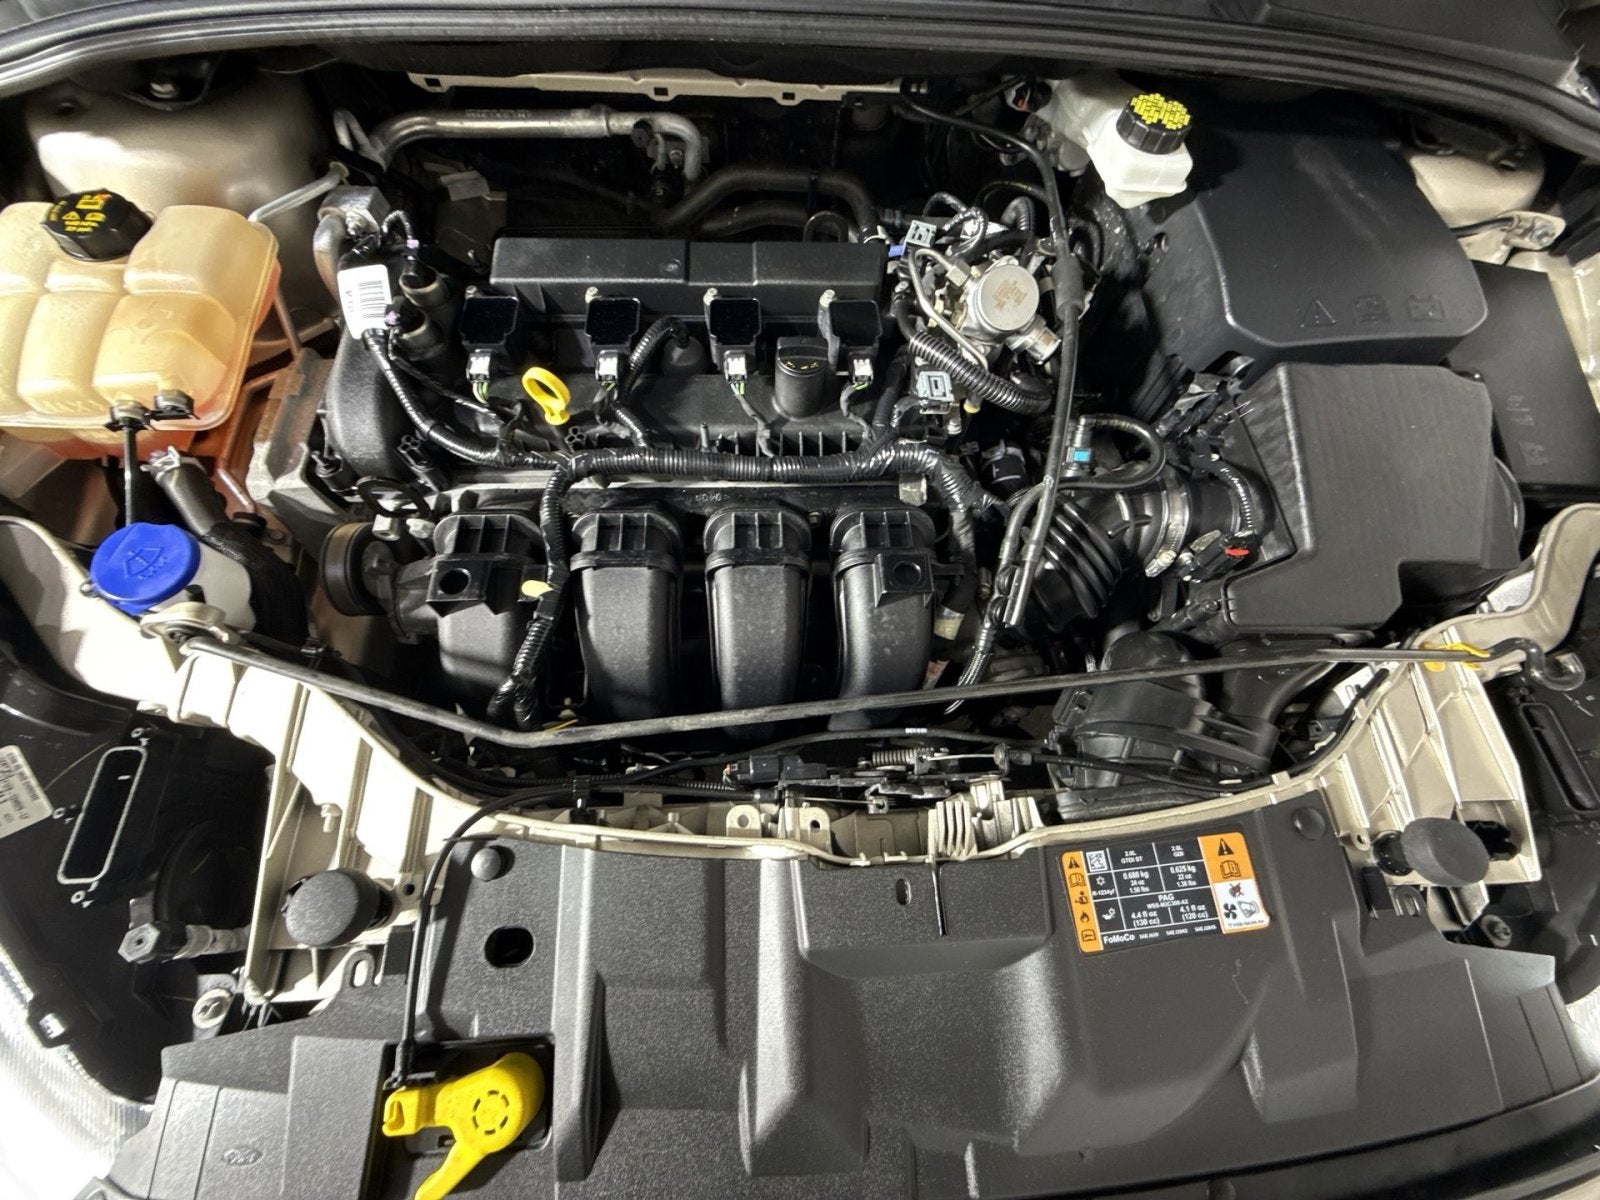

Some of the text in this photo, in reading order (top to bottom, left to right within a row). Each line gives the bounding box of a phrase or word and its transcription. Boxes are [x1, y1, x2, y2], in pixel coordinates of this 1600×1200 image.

[1187, 865, 1196, 873] kg
[1158, 894, 1174, 902] PAG
[1133, 919, 1148, 928] (130
[1103, 934, 1135, 944] FoMoCo
